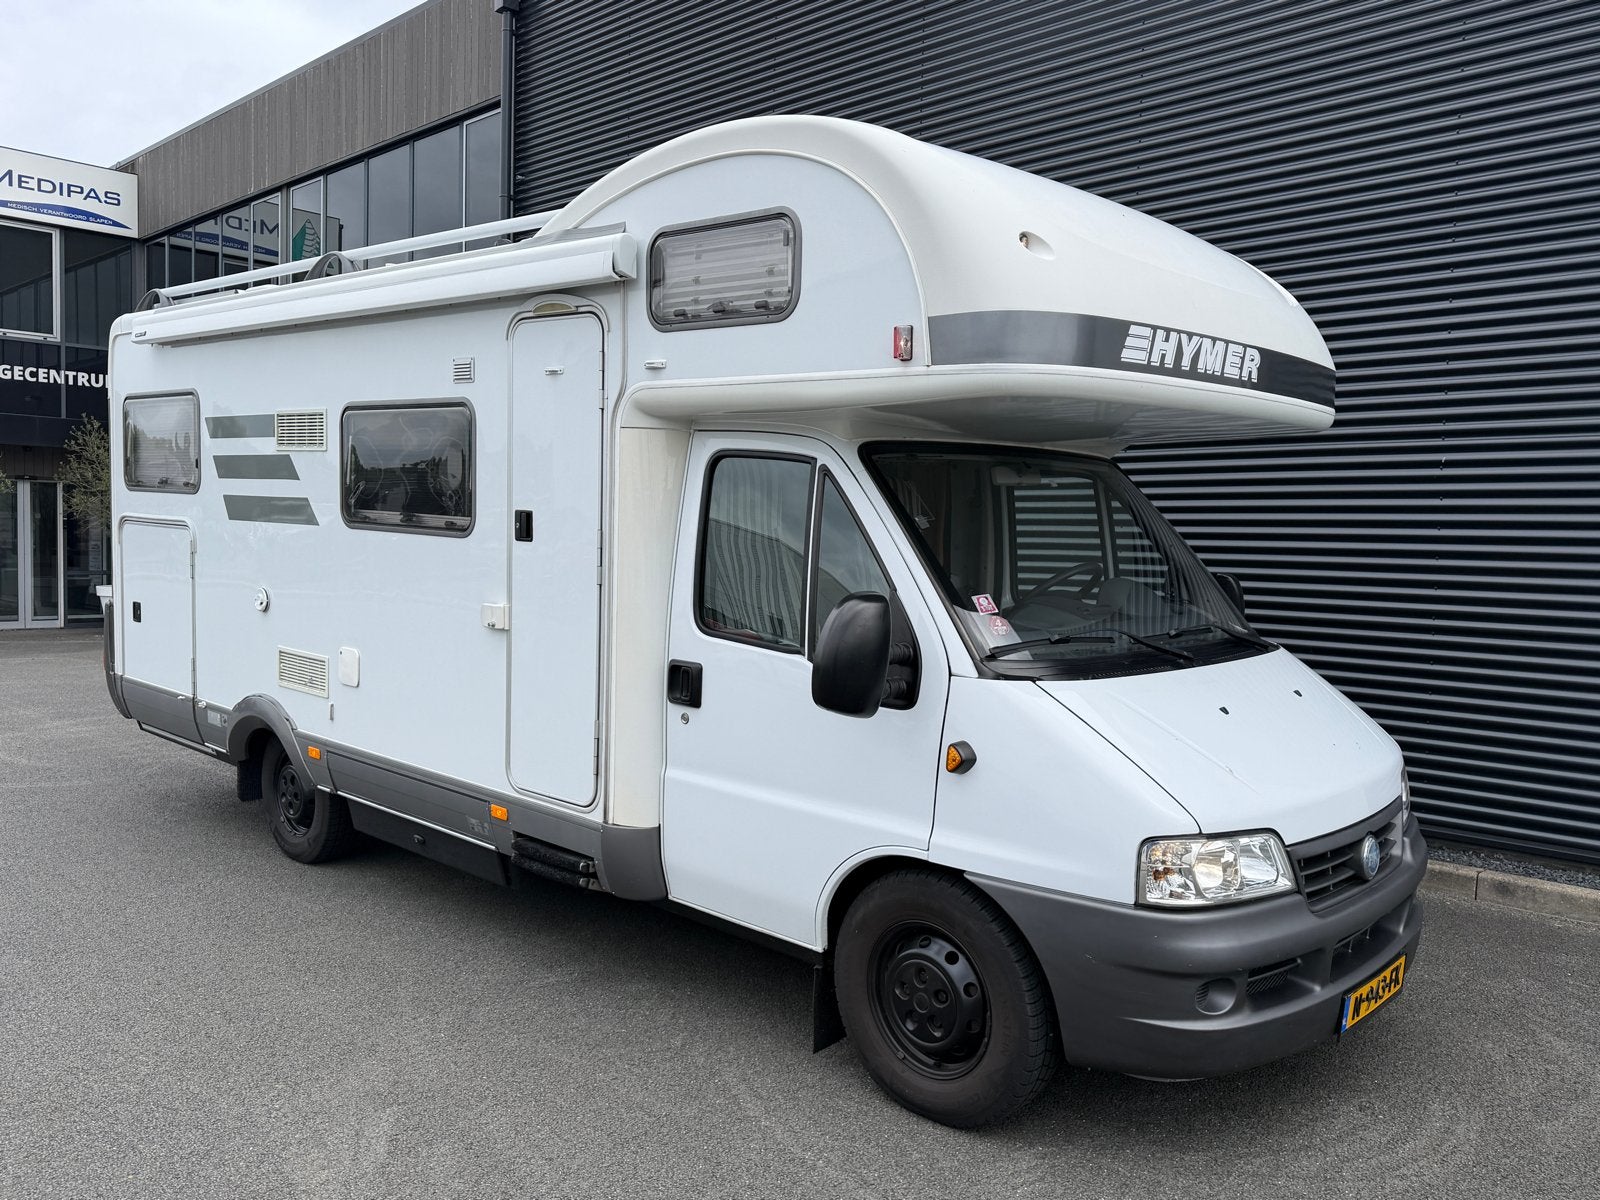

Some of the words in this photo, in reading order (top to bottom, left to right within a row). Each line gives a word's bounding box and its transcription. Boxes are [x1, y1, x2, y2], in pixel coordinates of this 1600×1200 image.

[7, 202, 38, 212] MEDISCH
[40, 207, 87, 221] VERANTWOORD
[89, 216, 113, 225] SLAPEN
[1150, 328, 1261, 383] HYMER
[0, 364, 108, 389] GECENTRU
